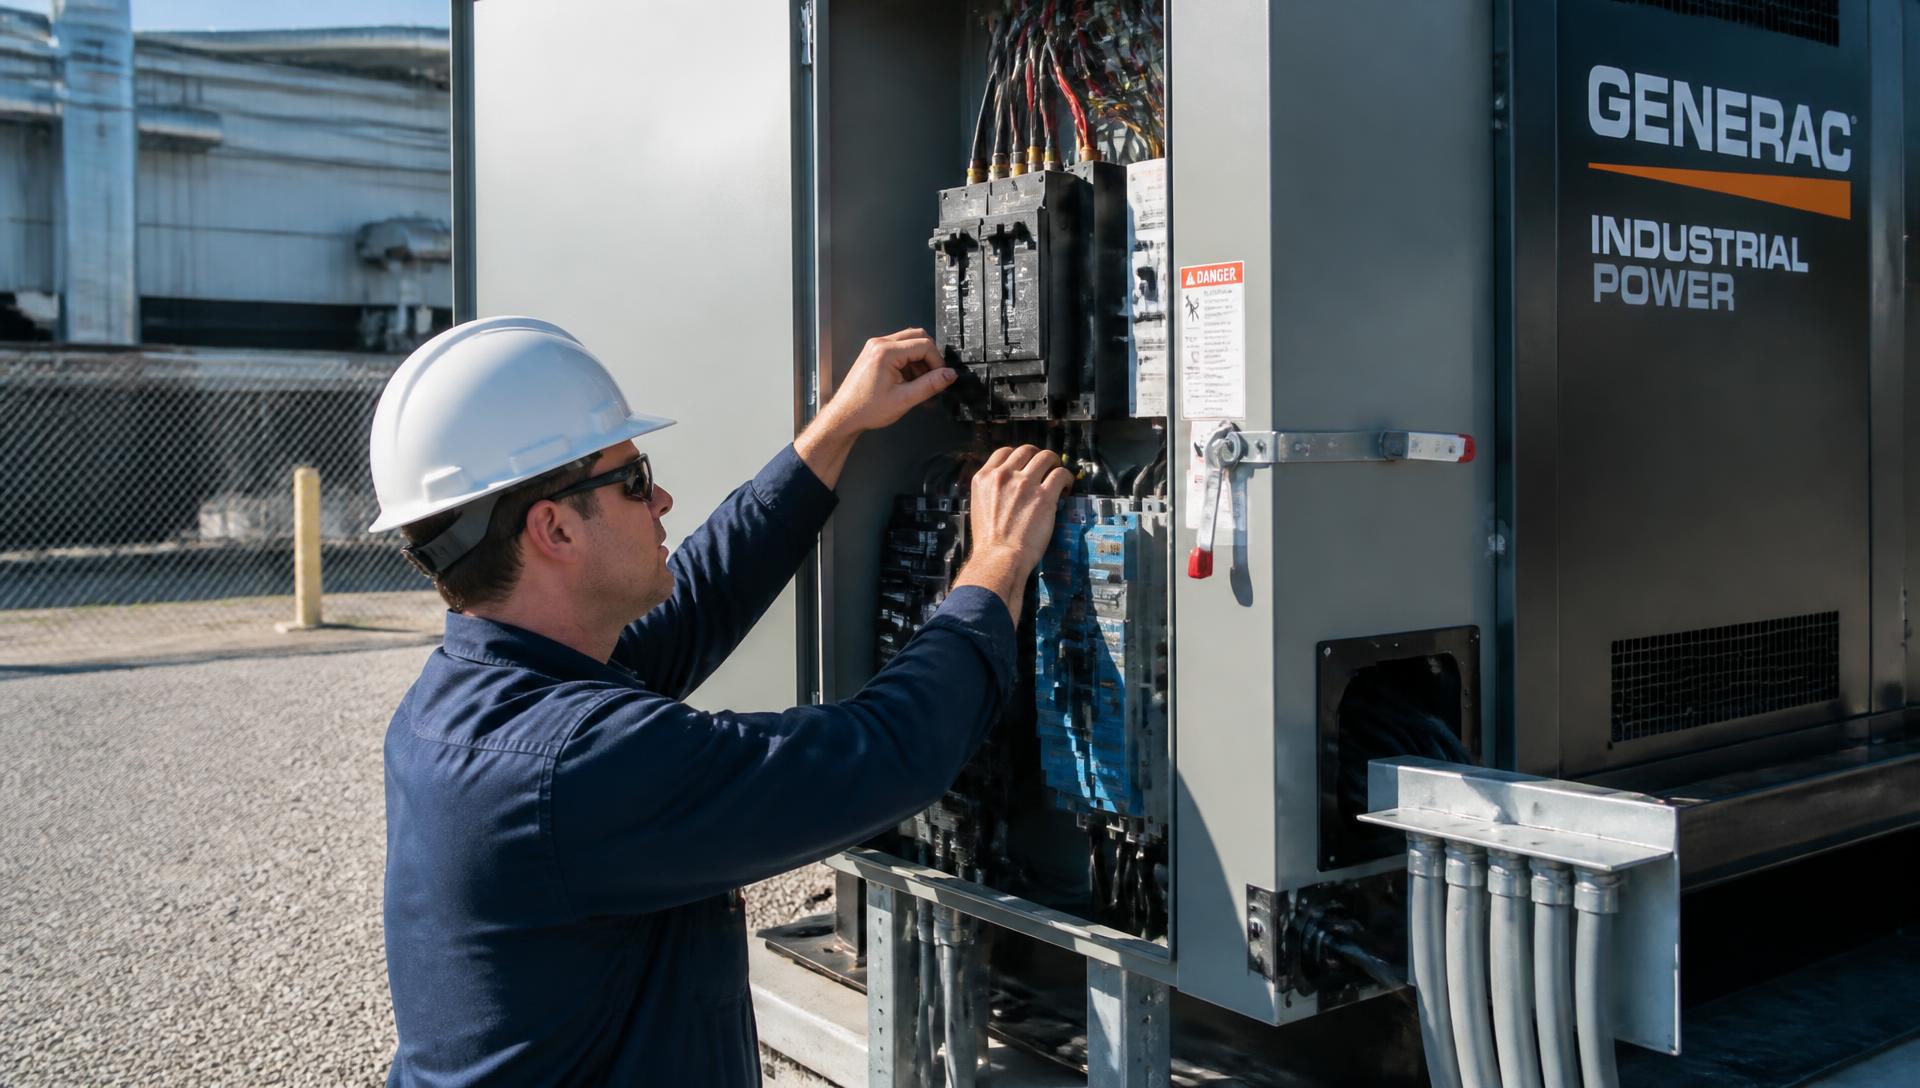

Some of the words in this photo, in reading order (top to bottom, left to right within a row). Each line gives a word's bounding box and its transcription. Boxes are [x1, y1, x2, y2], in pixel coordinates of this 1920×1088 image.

[1588, 64, 1852, 173] GENERAC
[1591, 214, 1809, 273] INDUSTRIAL
[1196, 267, 1237, 284] DANGER
[1593, 263, 1735, 312] POWER
